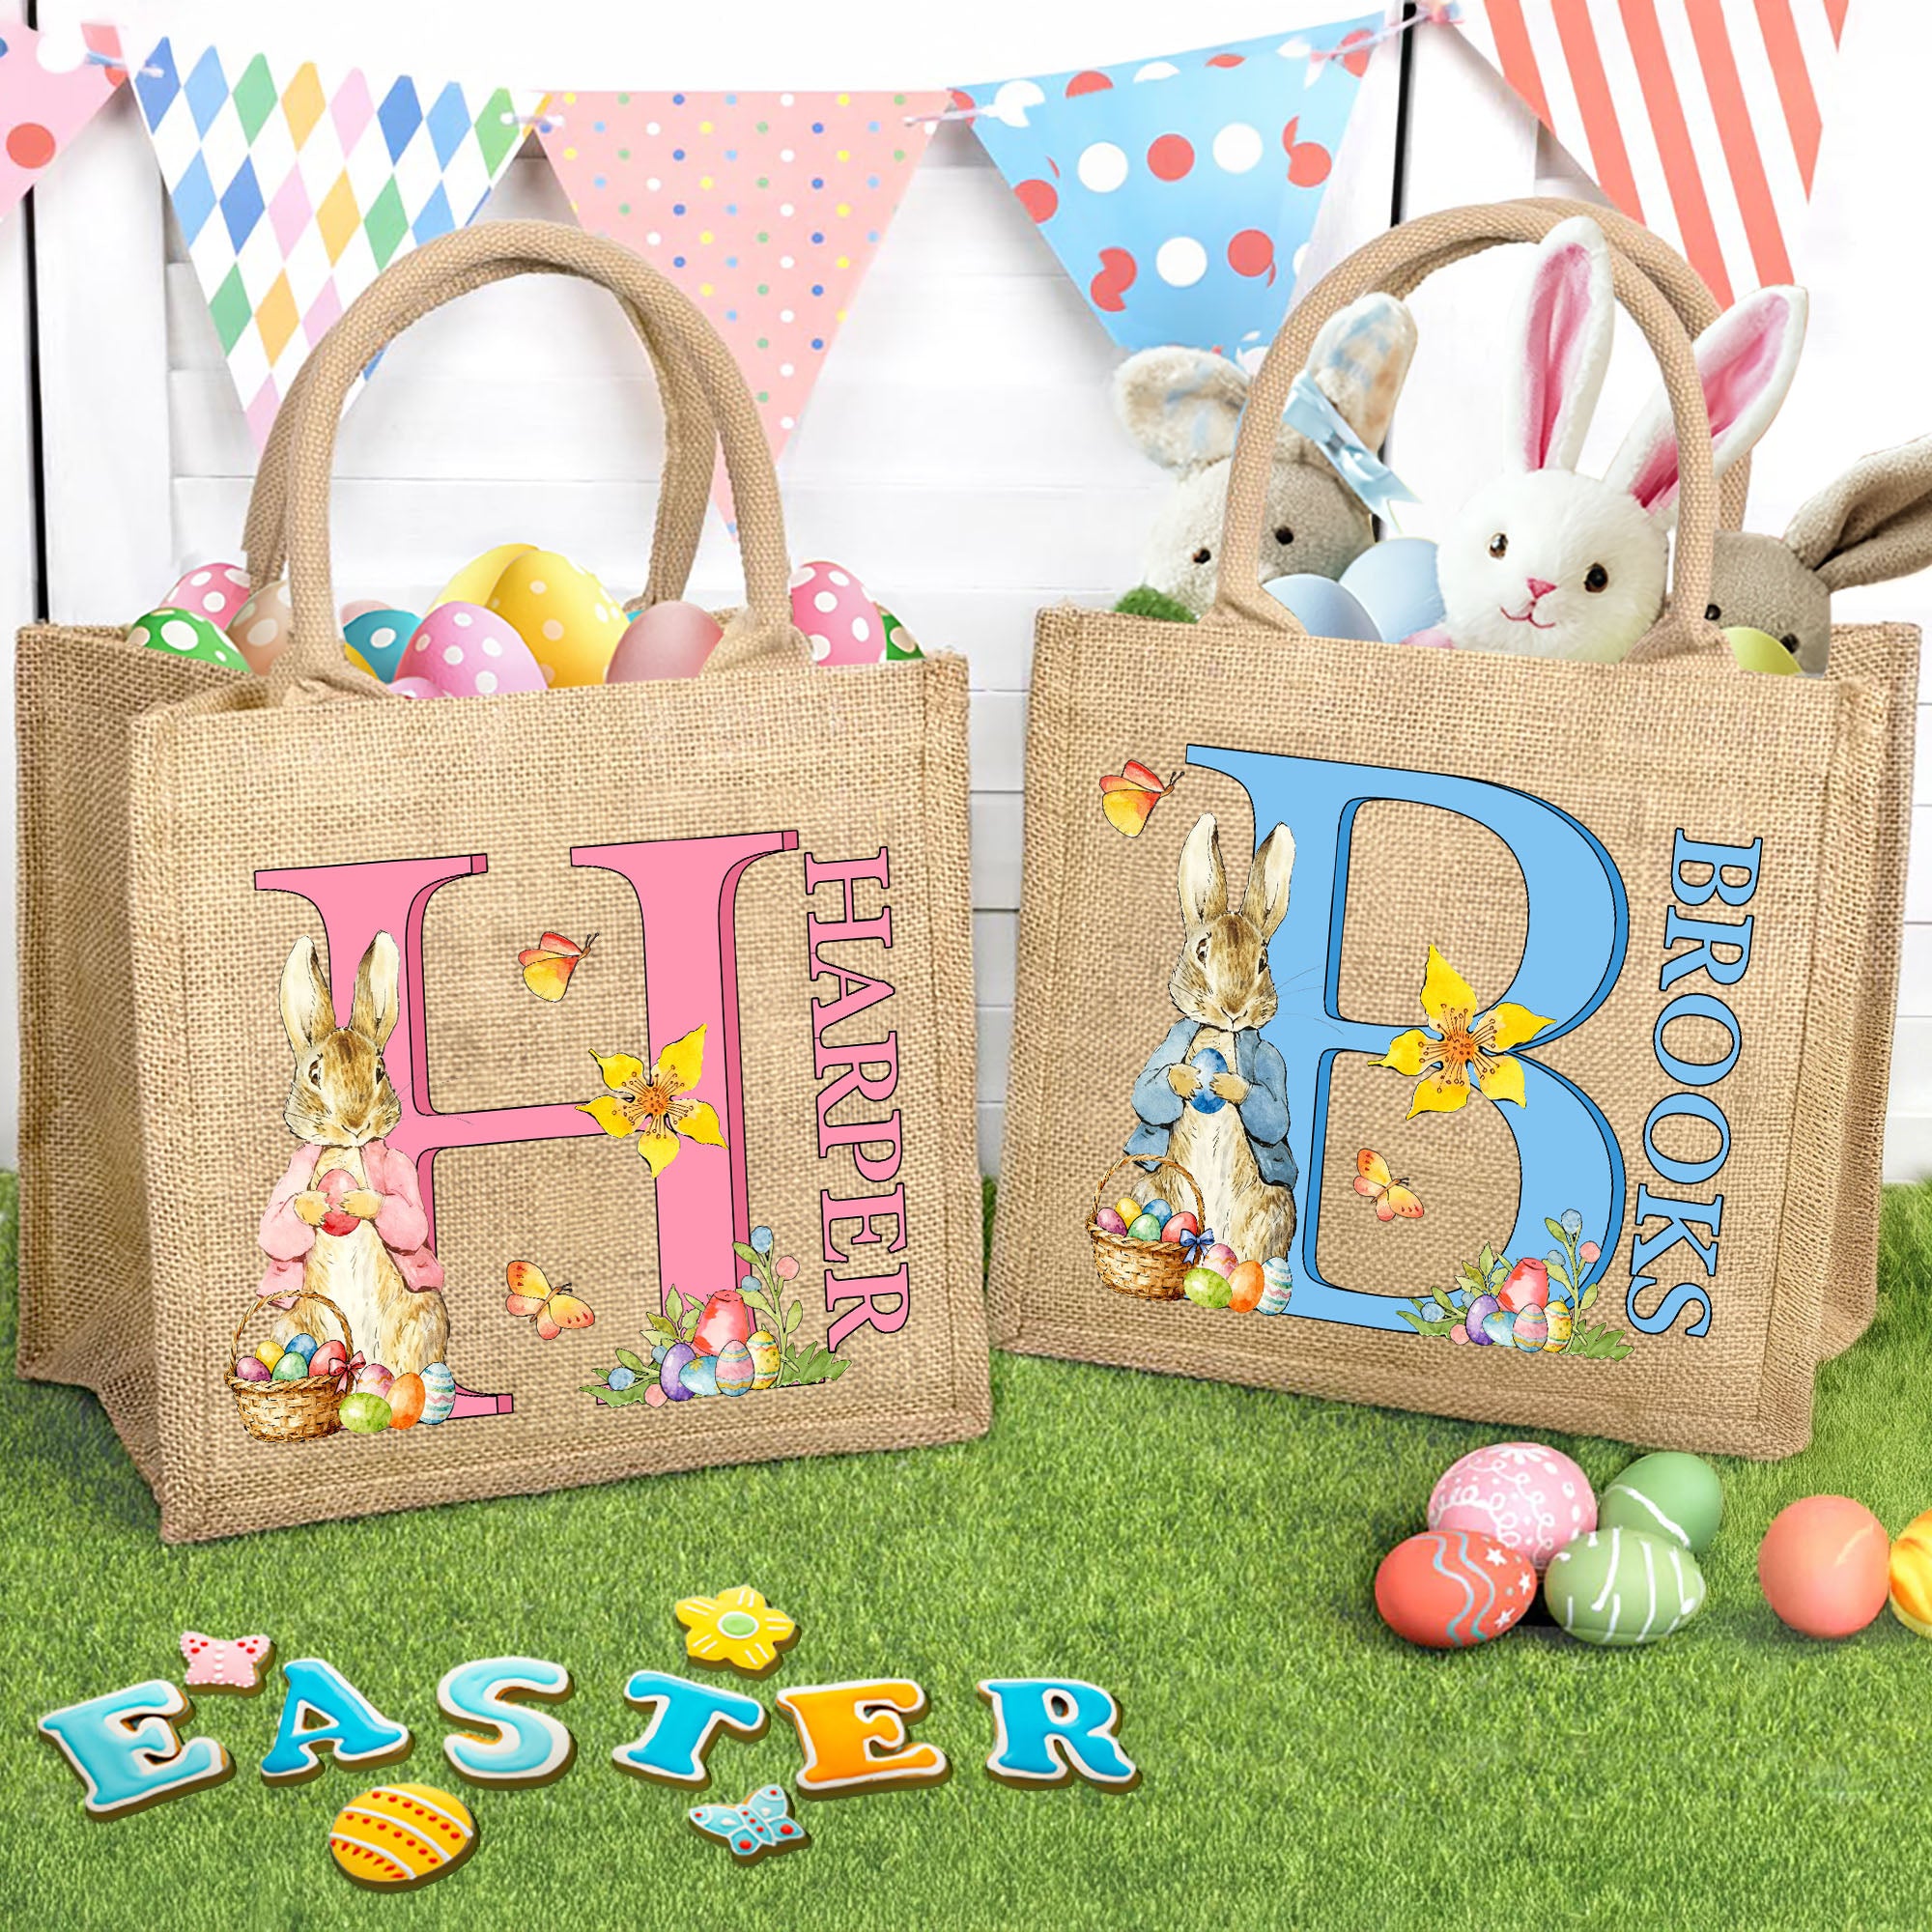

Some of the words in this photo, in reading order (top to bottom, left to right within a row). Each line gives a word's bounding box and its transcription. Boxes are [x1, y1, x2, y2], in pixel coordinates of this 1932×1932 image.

[254, 830, 826, 1430] H
[804, 846, 911, 1353] HARPER
[1185, 743, 1630, 1335] B
[1625, 827, 1763, 1340] BROOKS
[38, 1656, 1140, 1815] EASTER
